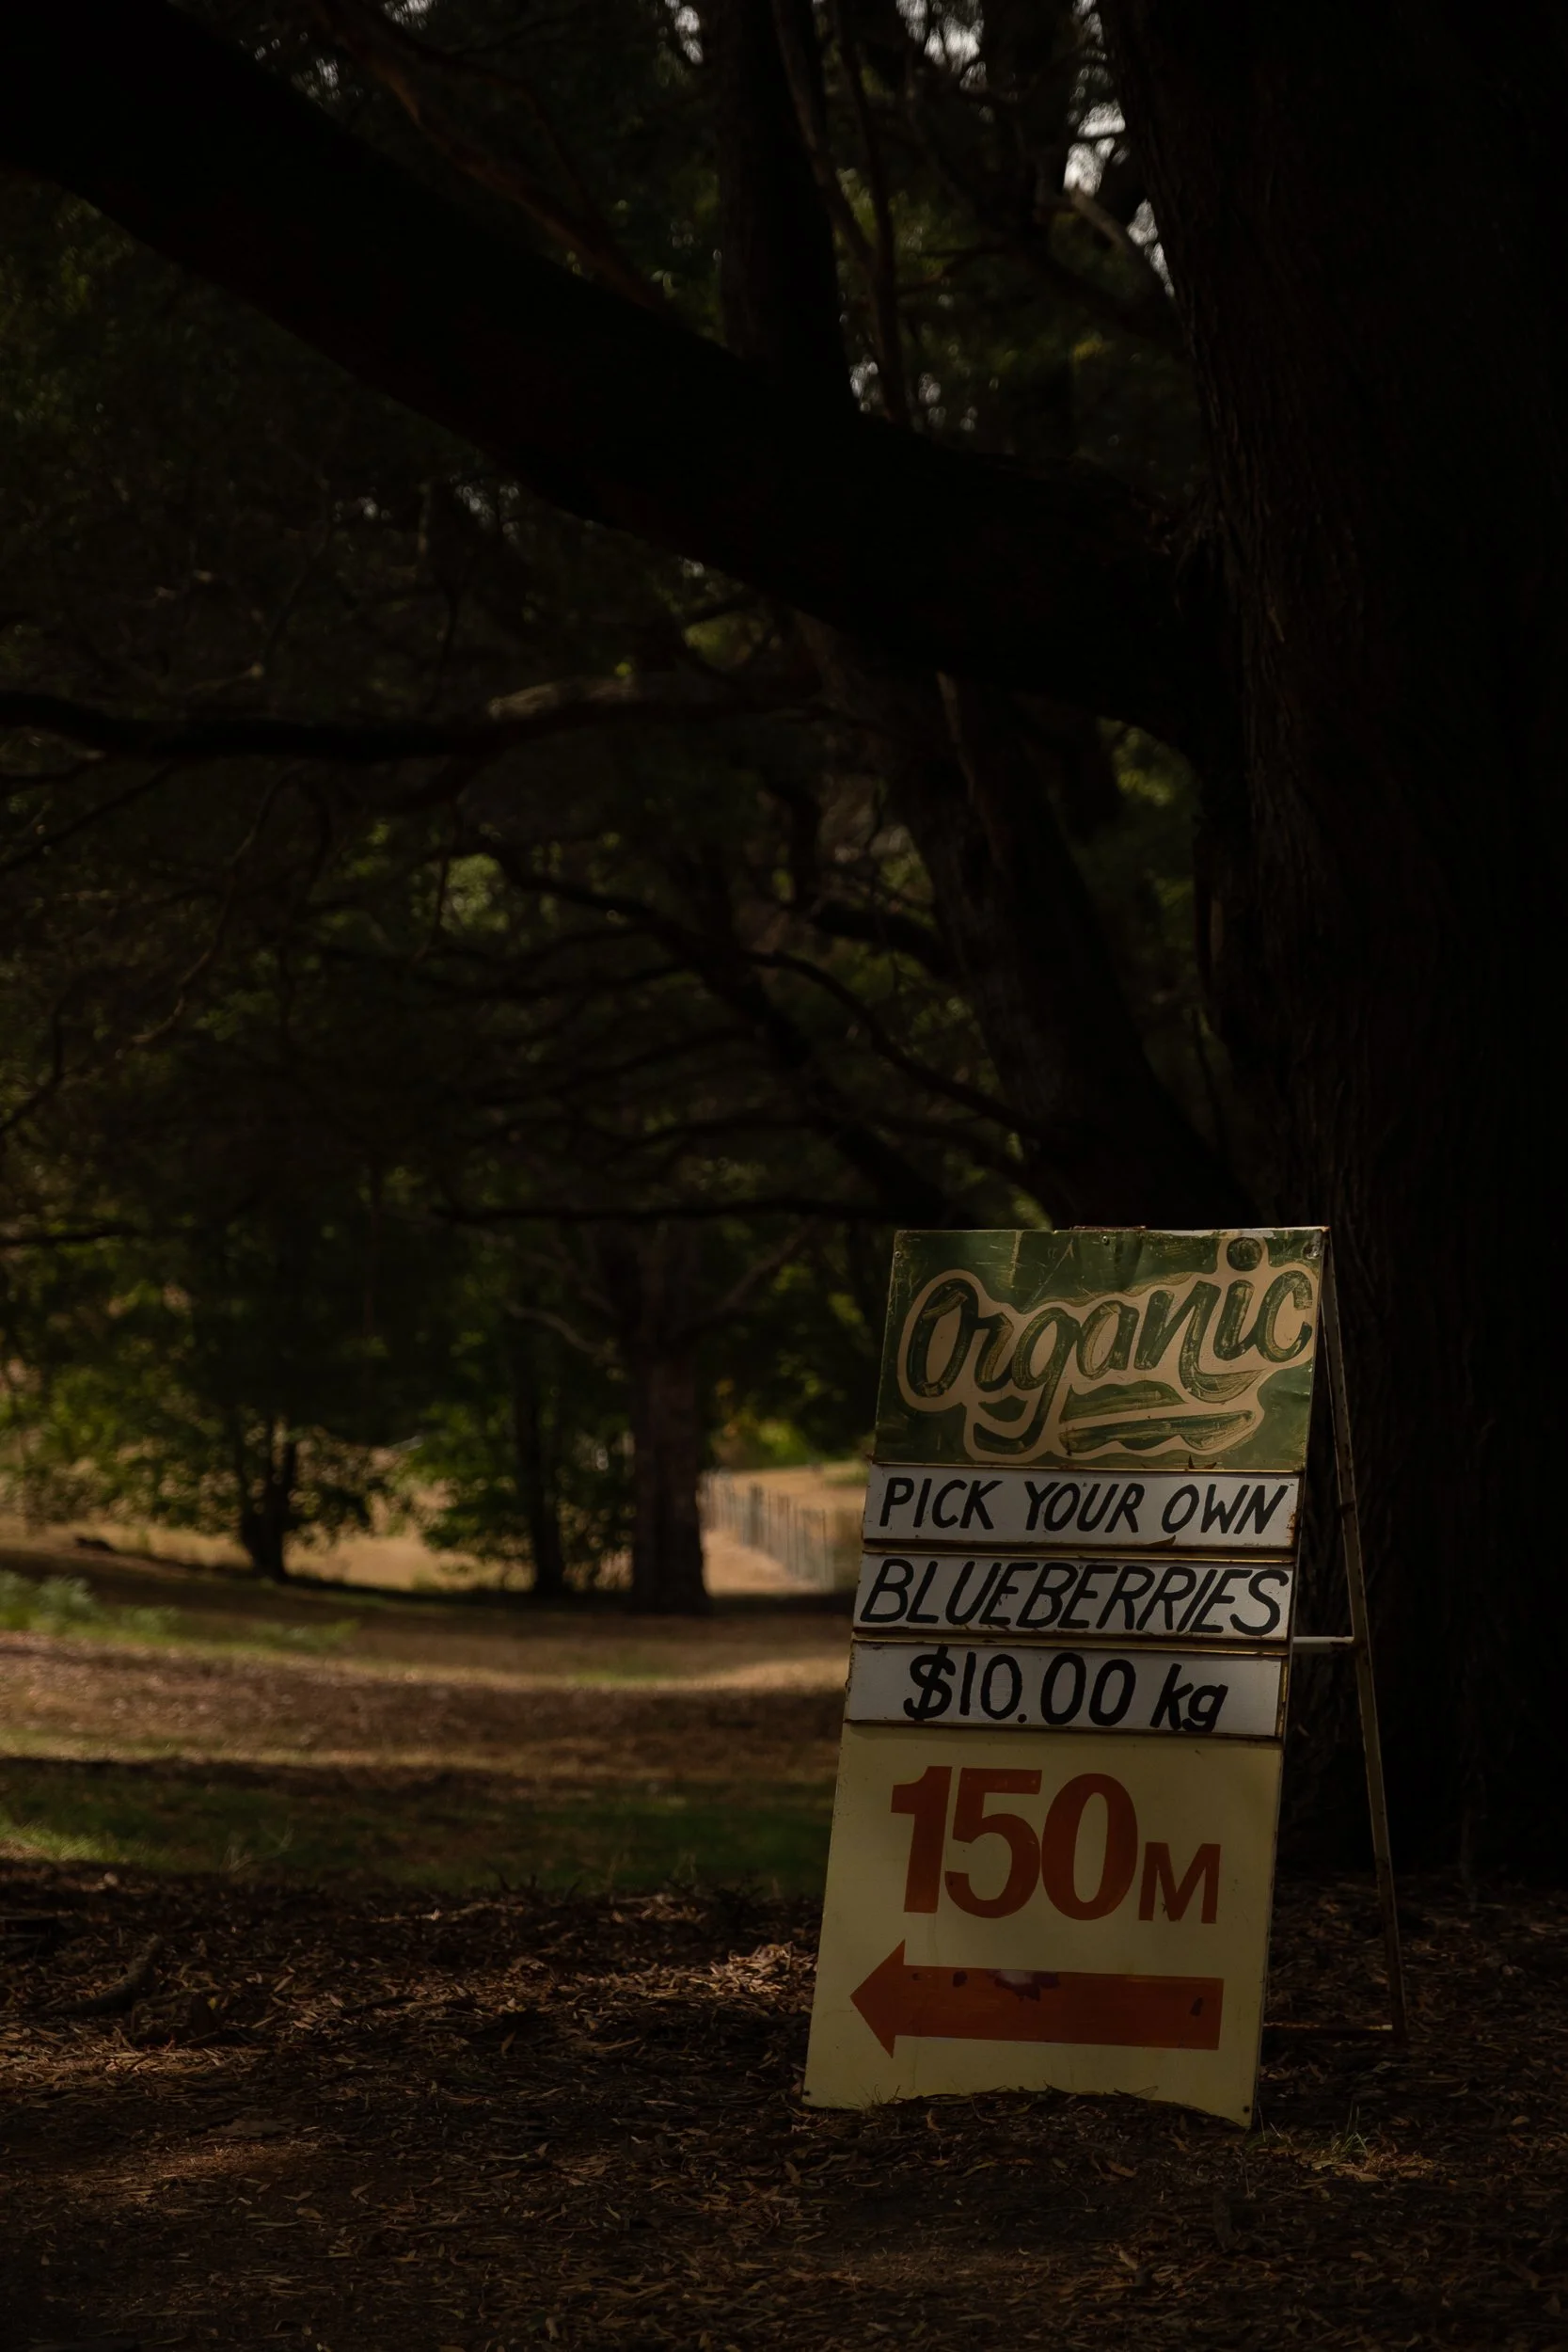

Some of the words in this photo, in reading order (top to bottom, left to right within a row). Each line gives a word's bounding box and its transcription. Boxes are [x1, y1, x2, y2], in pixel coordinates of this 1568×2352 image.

[905, 1235, 1314, 1454] Organic
[879, 1476, 1003, 1531] PICK
[1023, 1480, 1147, 1534] YOUR
[1161, 1483, 1289, 1535] OWN
[860, 1558, 1290, 1636] BLUEBERRIES
[903, 1645, 1136, 1726] $10.00
[1149, 1662, 1229, 1733] kg
[890, 1766, 1221, 1925] 150M
